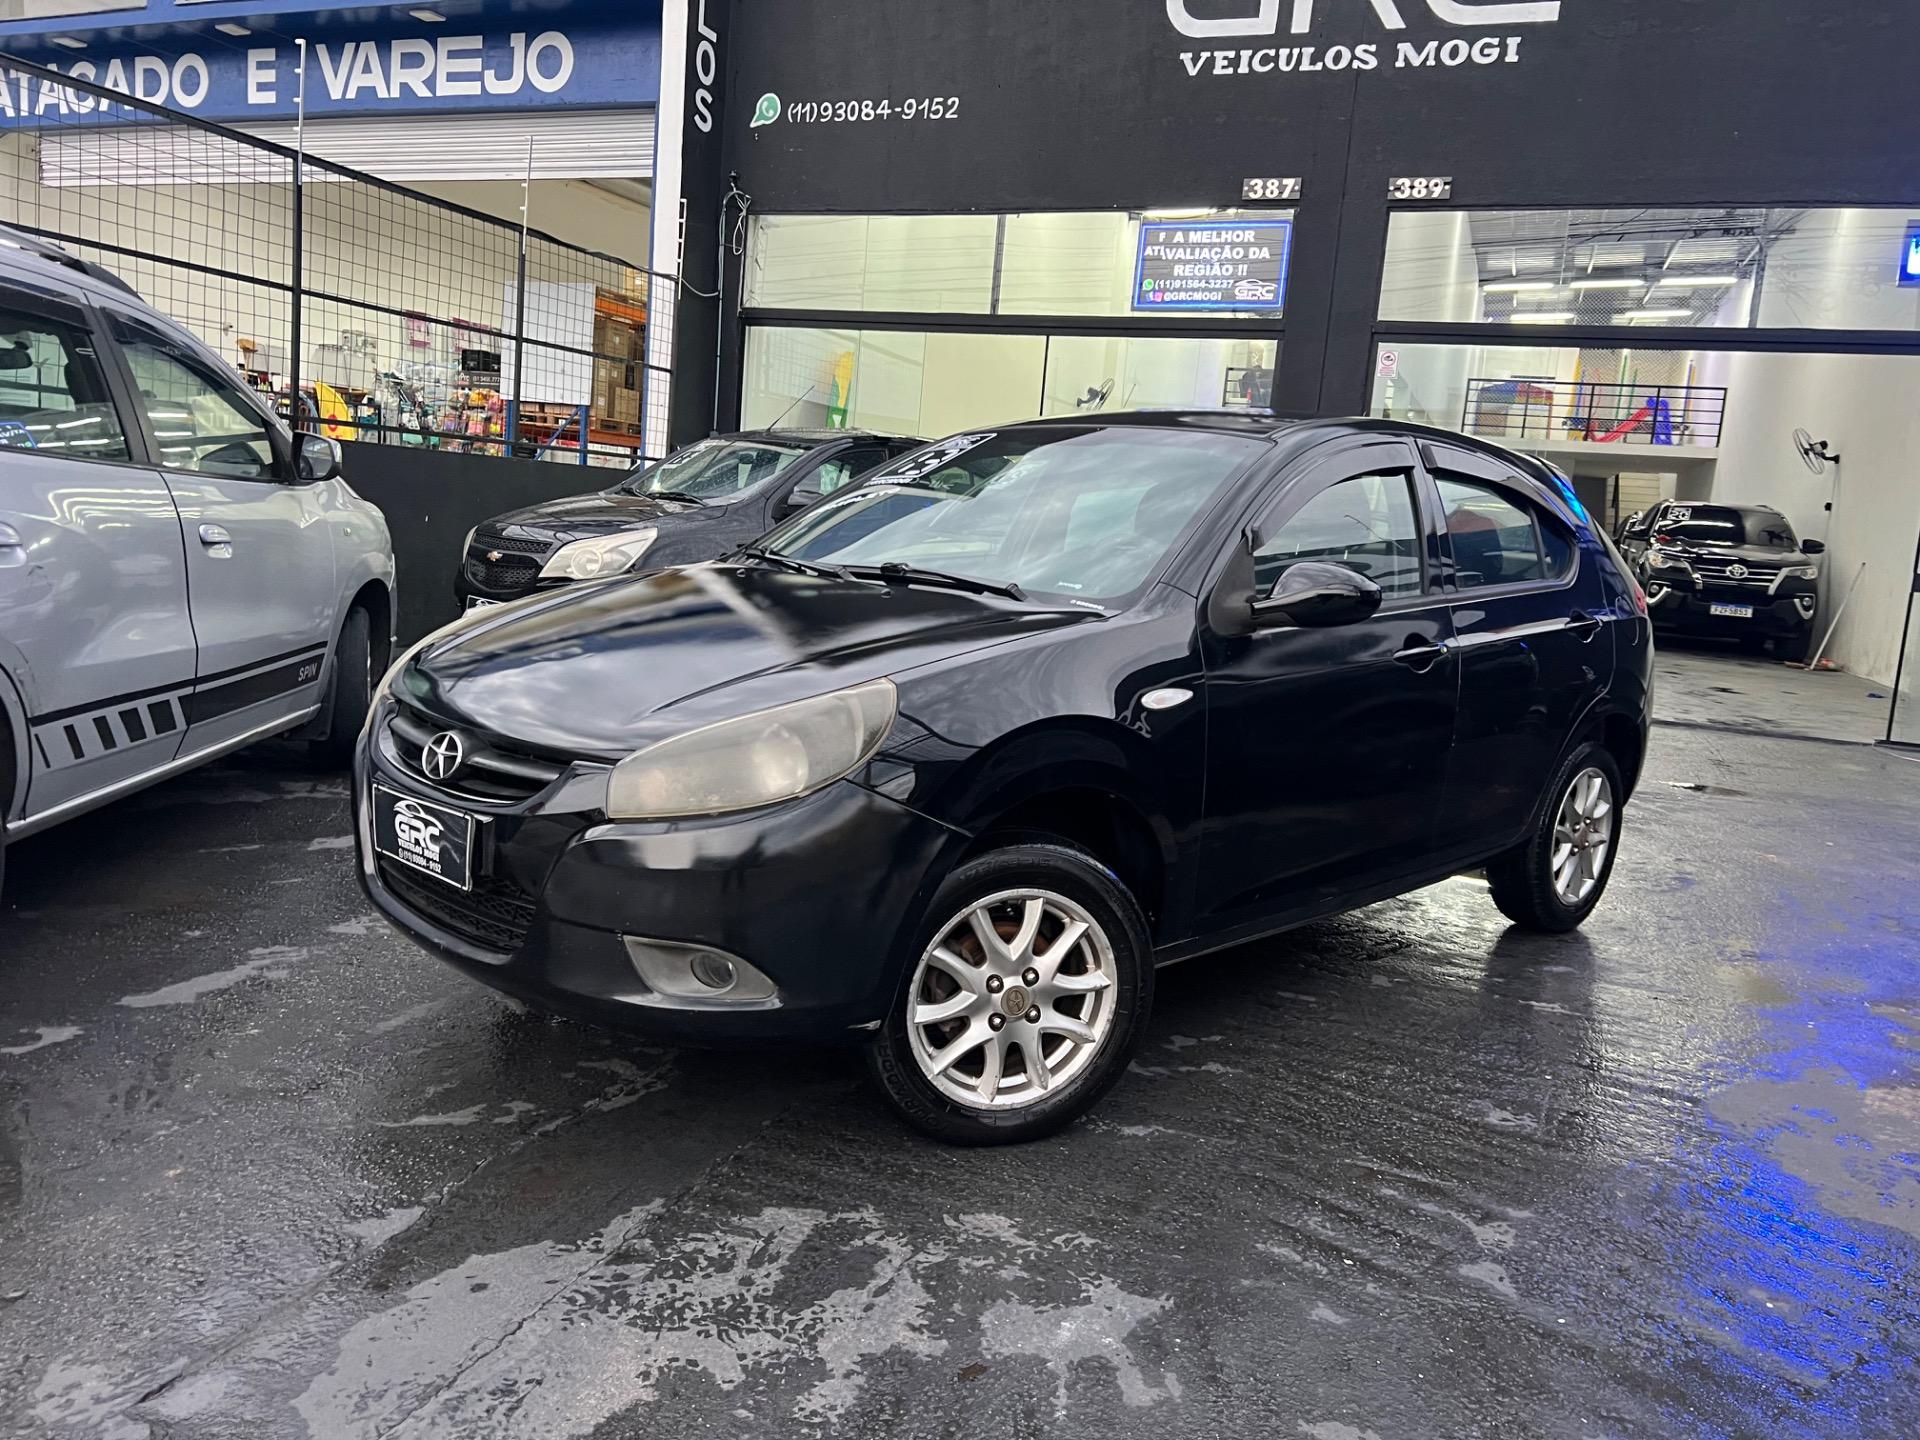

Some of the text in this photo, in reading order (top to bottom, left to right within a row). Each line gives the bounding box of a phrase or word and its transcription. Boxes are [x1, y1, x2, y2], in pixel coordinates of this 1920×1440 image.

[1179, 36, 1522, 76] VEICULOS MOGI
[247, 47, 276, 104] E
[316, 30, 574, 100] VAREJO
[787, 97, 960, 123] (11)93084-9152
[1248, 177, 1295, 199] 387
[1394, 177, 1443, 198] 389
[1172, 231, 1185, 243] A
[1188, 230, 1256, 243] MELHOR
[1249, 247, 1271, 259] DA
[1174, 261, 1248, 276] REGIÃO !!
[1164, 291, 1222, 301] @GRCMOGI
[1234, 286, 1275, 298] GRC
[298, 662, 318, 681] SPIN
[394, 814, 440, 854] GRC
